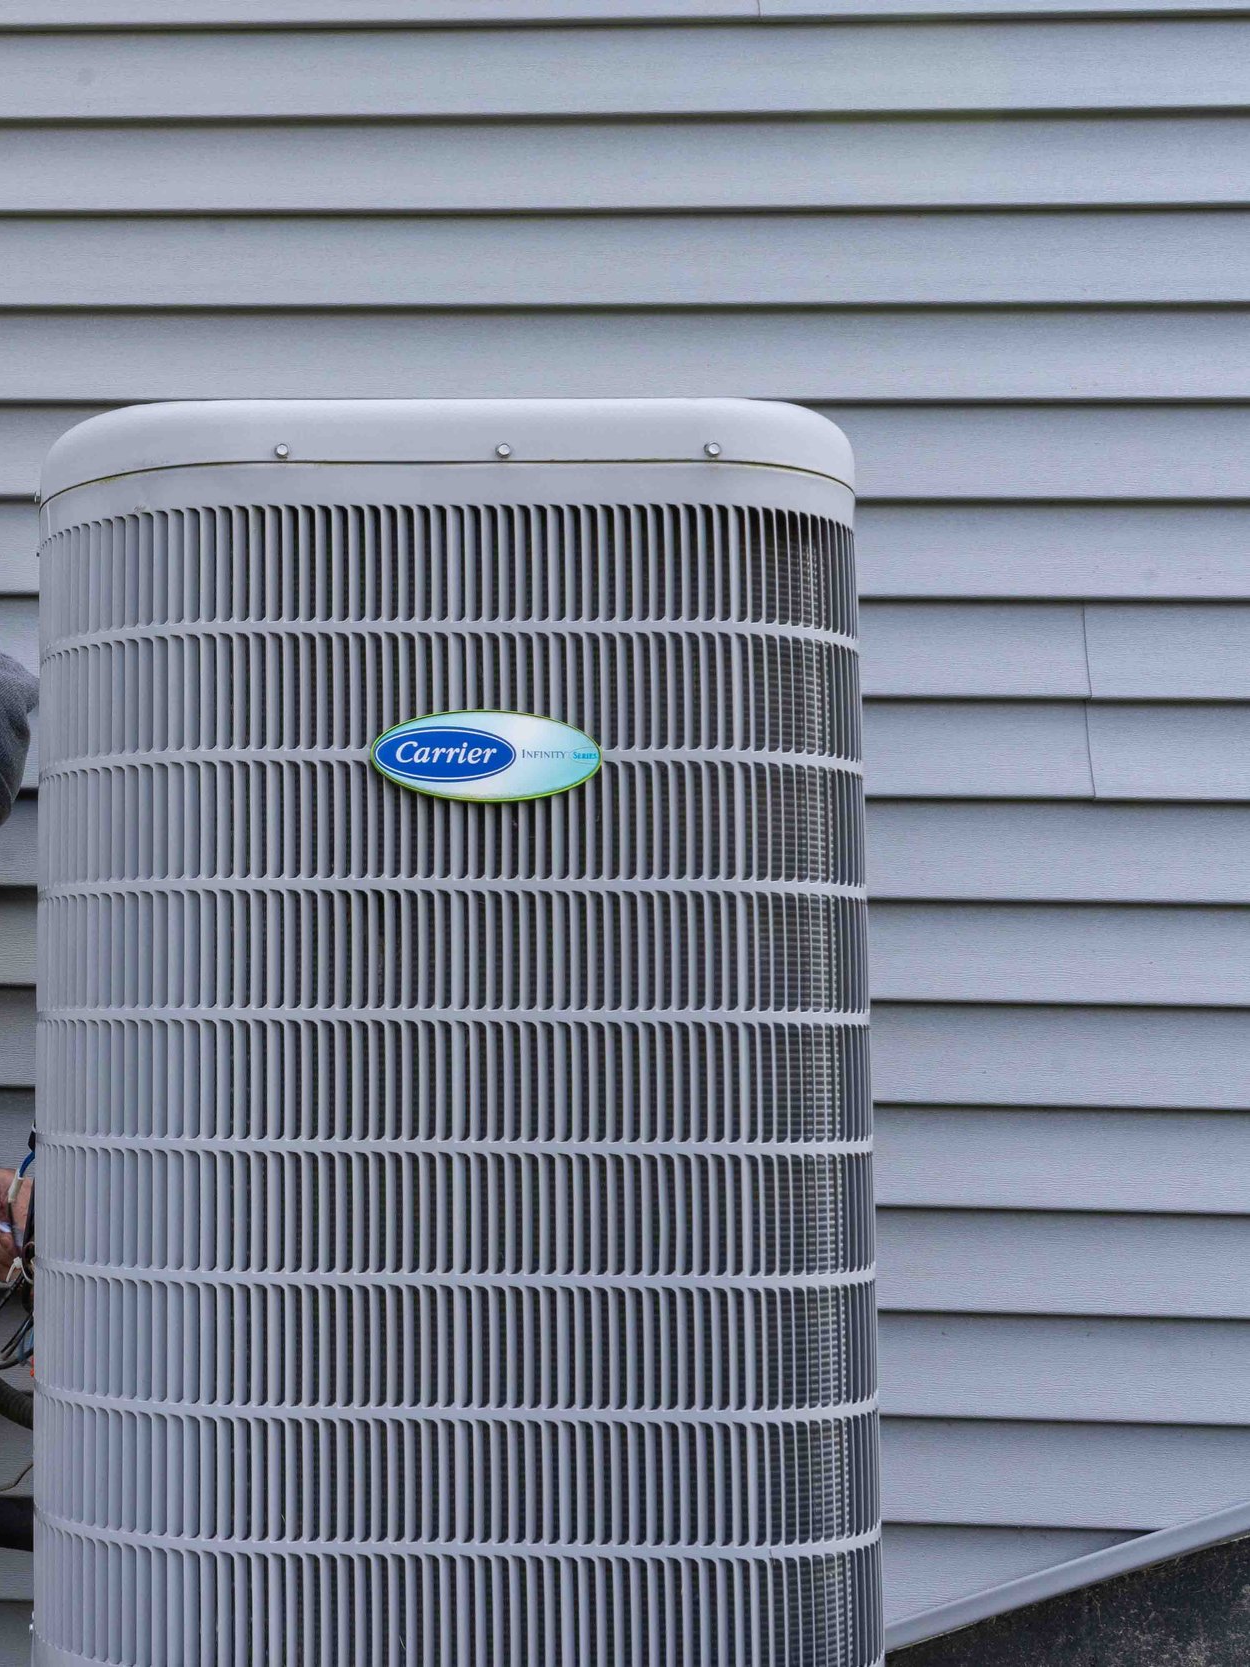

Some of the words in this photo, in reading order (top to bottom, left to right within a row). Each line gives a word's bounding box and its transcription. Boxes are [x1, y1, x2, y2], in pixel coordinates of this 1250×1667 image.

[395, 741, 498, 765] Carrier
[521, 748, 567, 760] INFINITY
[572, 750, 598, 761] SERIES
